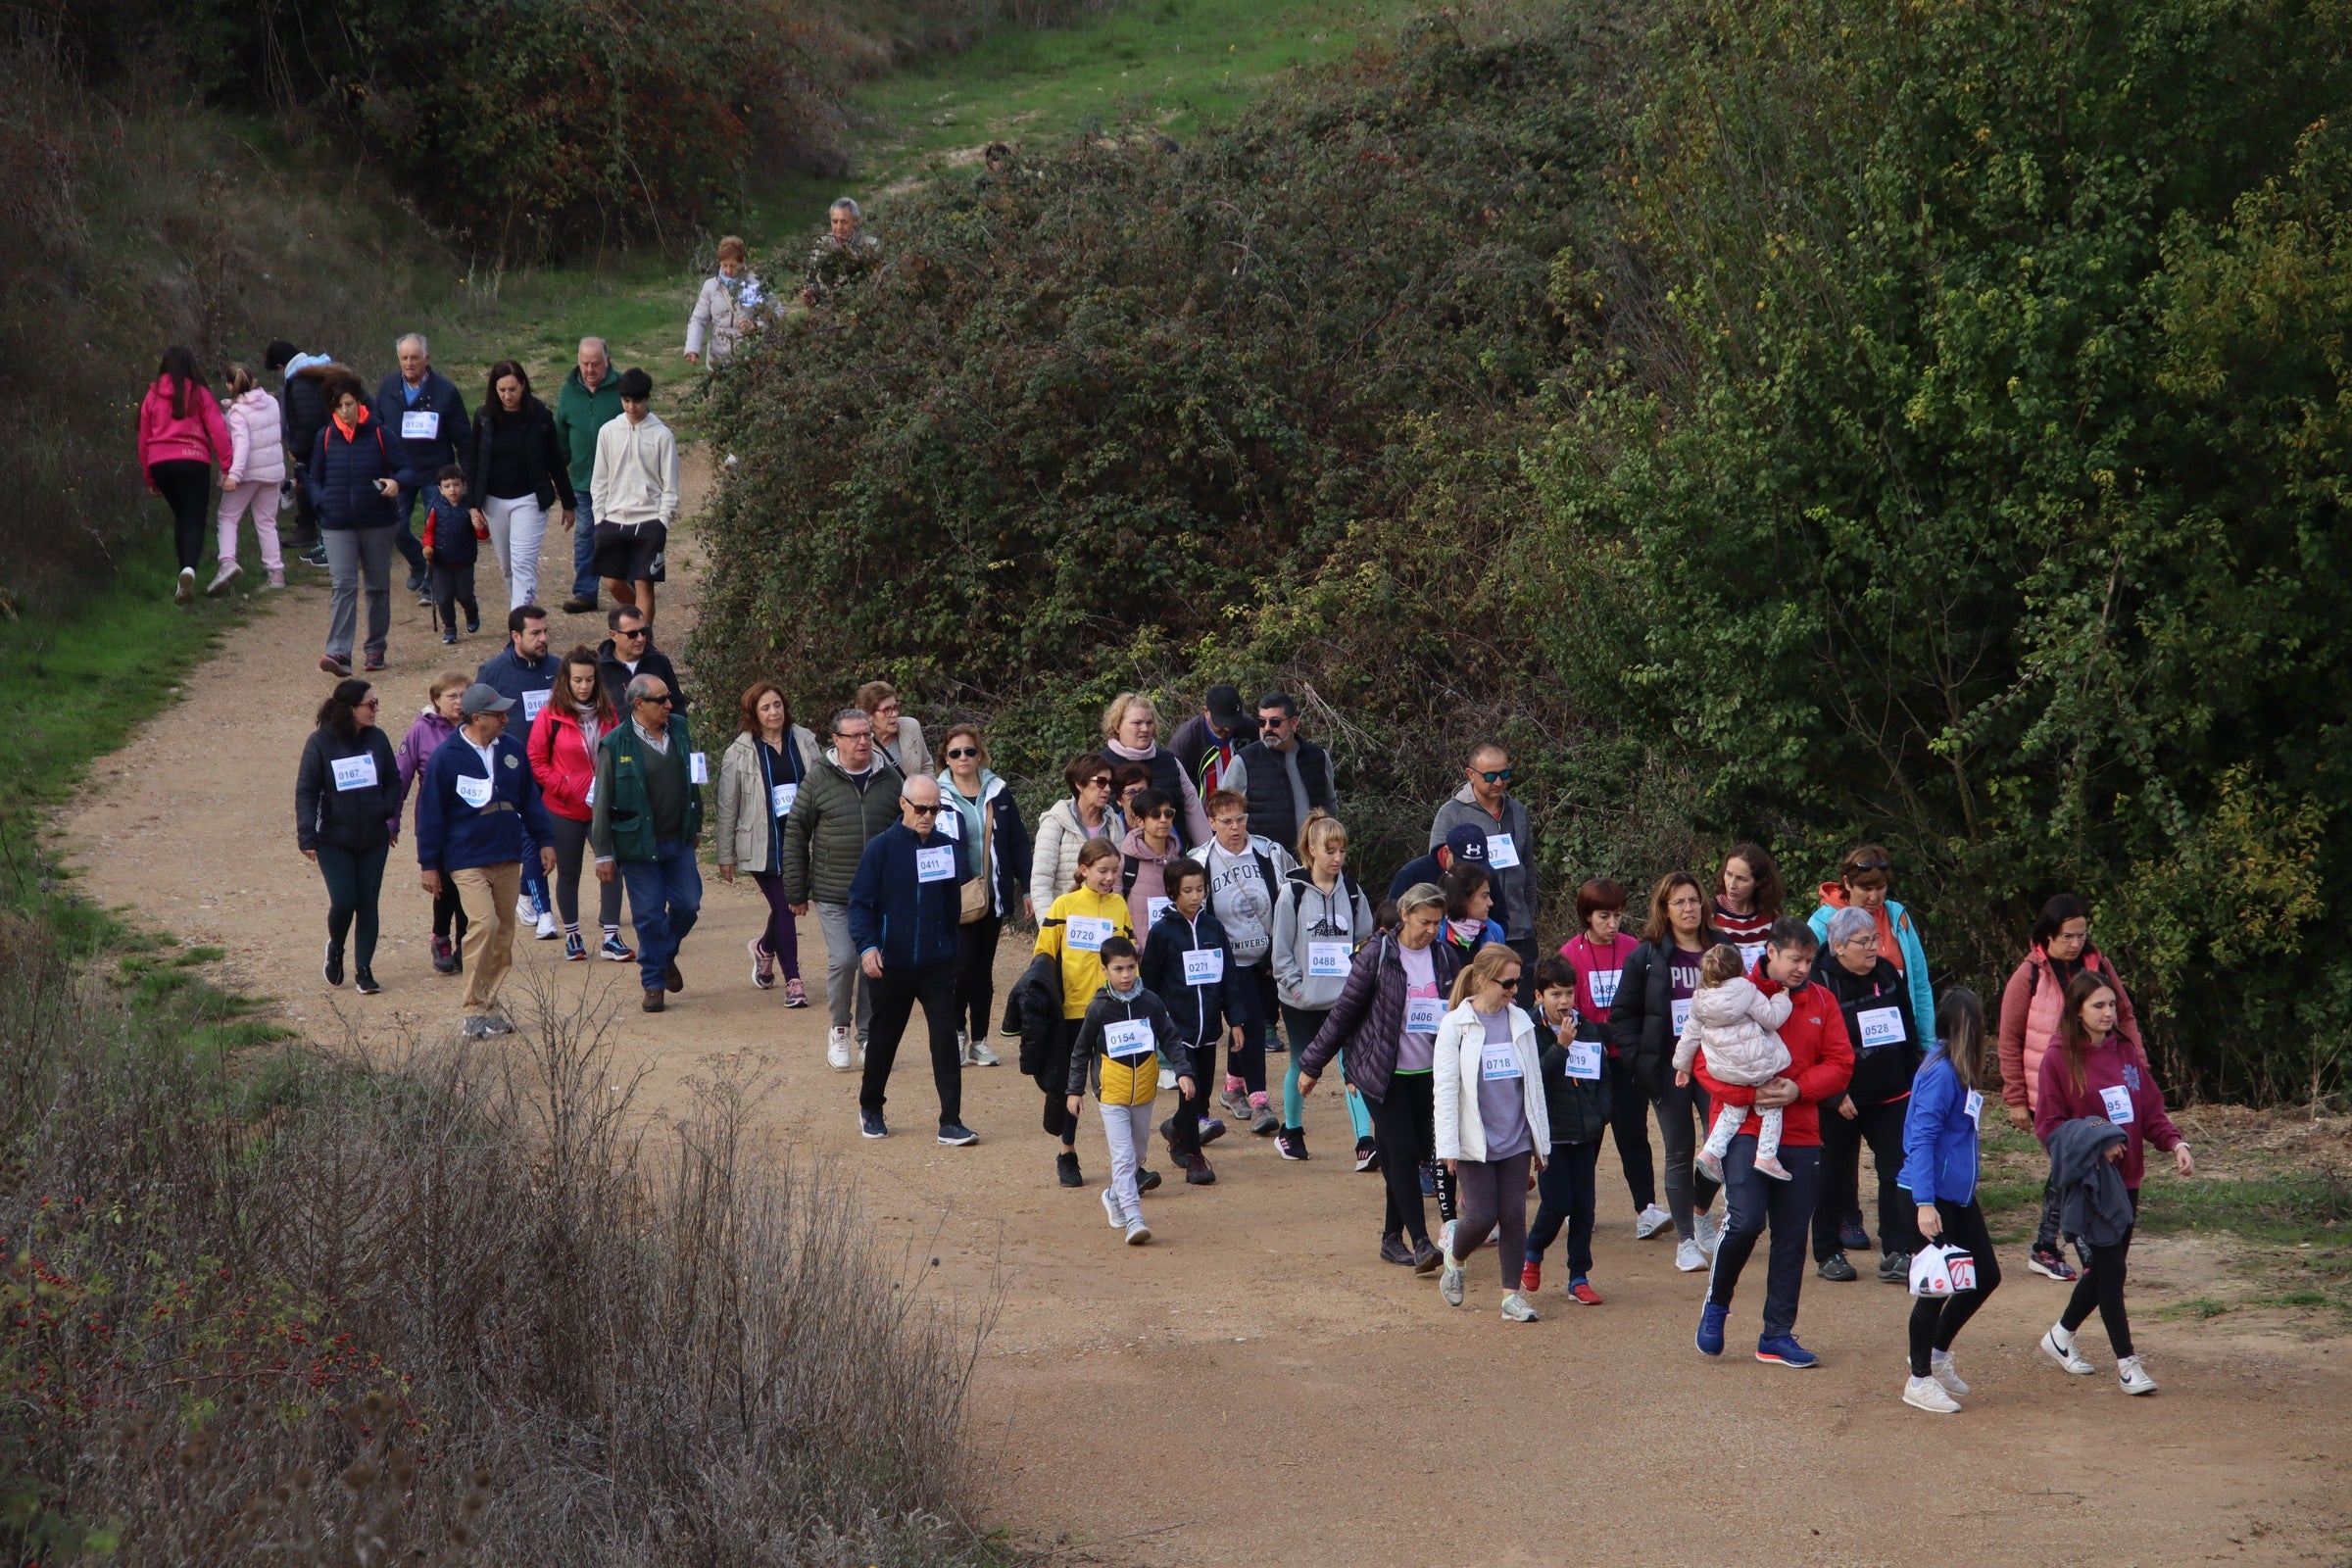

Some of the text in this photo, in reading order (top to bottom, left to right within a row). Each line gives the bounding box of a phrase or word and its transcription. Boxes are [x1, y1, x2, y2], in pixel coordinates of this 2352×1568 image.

[338, 768, 359, 780] 0167
[460, 786, 483, 798] 0457
[920, 859, 940, 870] 0411
[1211, 864, 1264, 894] OXFOR
[1070, 929, 1095, 941] 0720
[1188, 962, 1208, 972] 0271
[1312, 956, 1336, 966] 0488
[1410, 1012, 1433, 1022] 0406
[1865, 1023, 1889, 1036] 0528
[1109, 1032, 1136, 1045] 0154
[1486, 1057, 1511, 1070] 0718
[2107, 1100, 2122, 1112] 95
